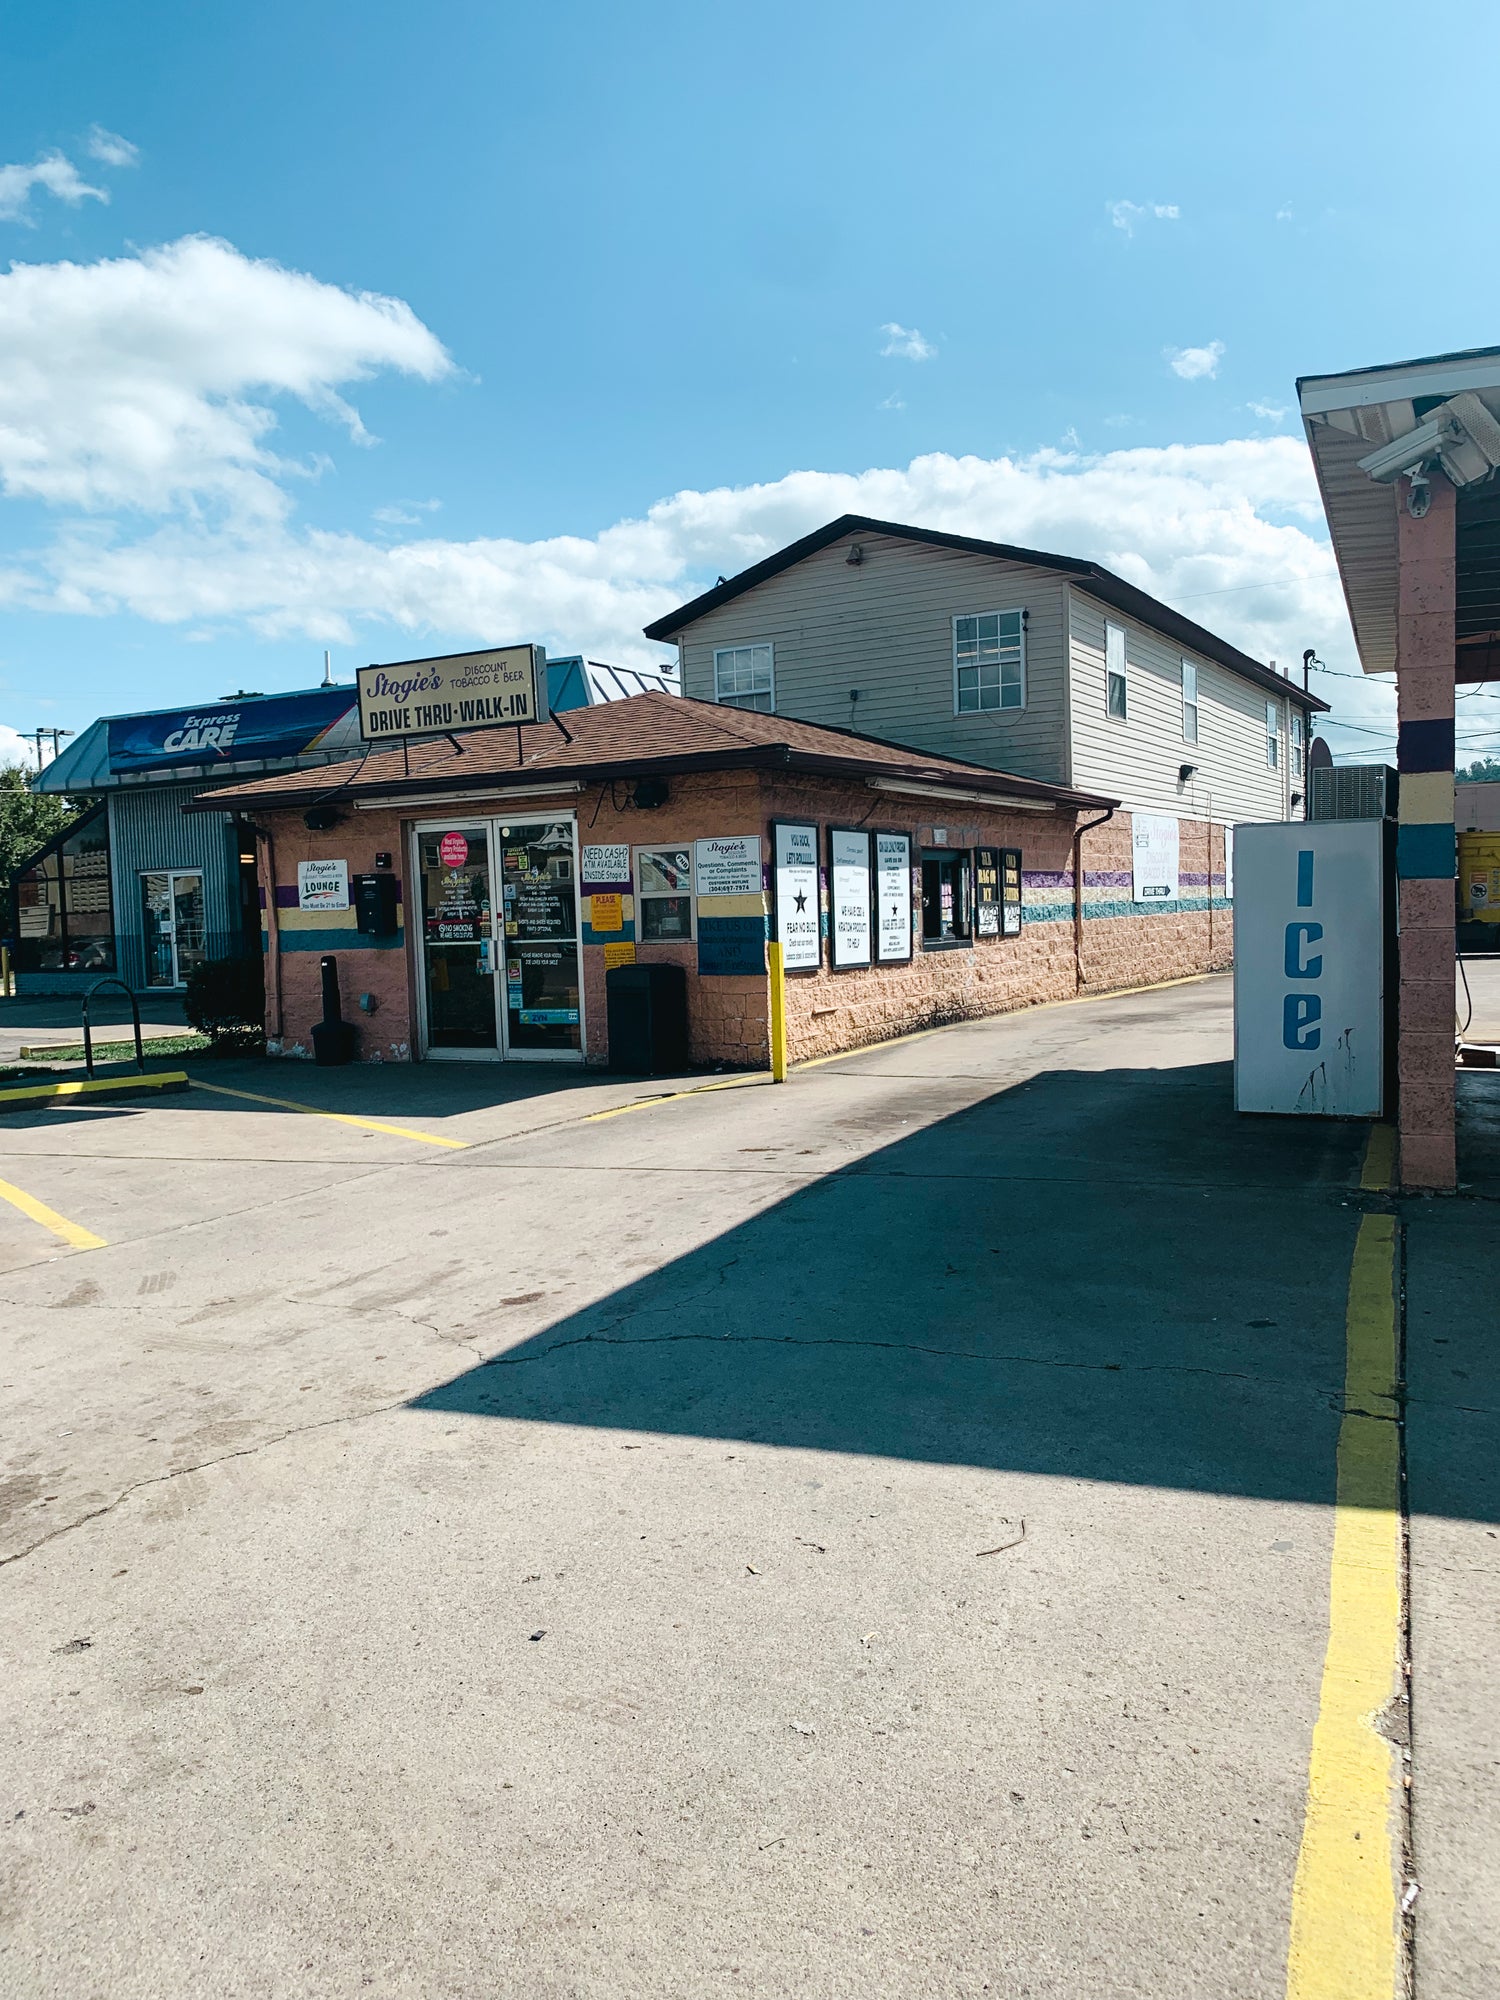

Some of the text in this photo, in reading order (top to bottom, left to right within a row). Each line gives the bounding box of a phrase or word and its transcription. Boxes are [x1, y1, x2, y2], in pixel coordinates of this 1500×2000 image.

[464, 662, 508, 676] DISCOUNT
[367, 667, 443, 703] Stogie's
[450, 674, 490, 688] TOBACCO
[503, 670, 525, 683] BEER
[184, 713, 241, 729] Express
[369, 707, 411, 733] DRIVE
[163, 724, 239, 755] CARE
[584, 848, 628, 860] NEED CASH?
[707, 841, 745, 854] Stogie's
[307, 862, 336, 875] Stogie's
[584, 859, 627, 869] ATM AVAILABLE
[584, 870, 604, 880] INSIDE
[306, 881, 340, 893] LOUNGE
[595, 895, 616, 904] PLEASE
[786, 922, 798, 934] FEAR
[531, 1014, 548, 1022] ZYN
